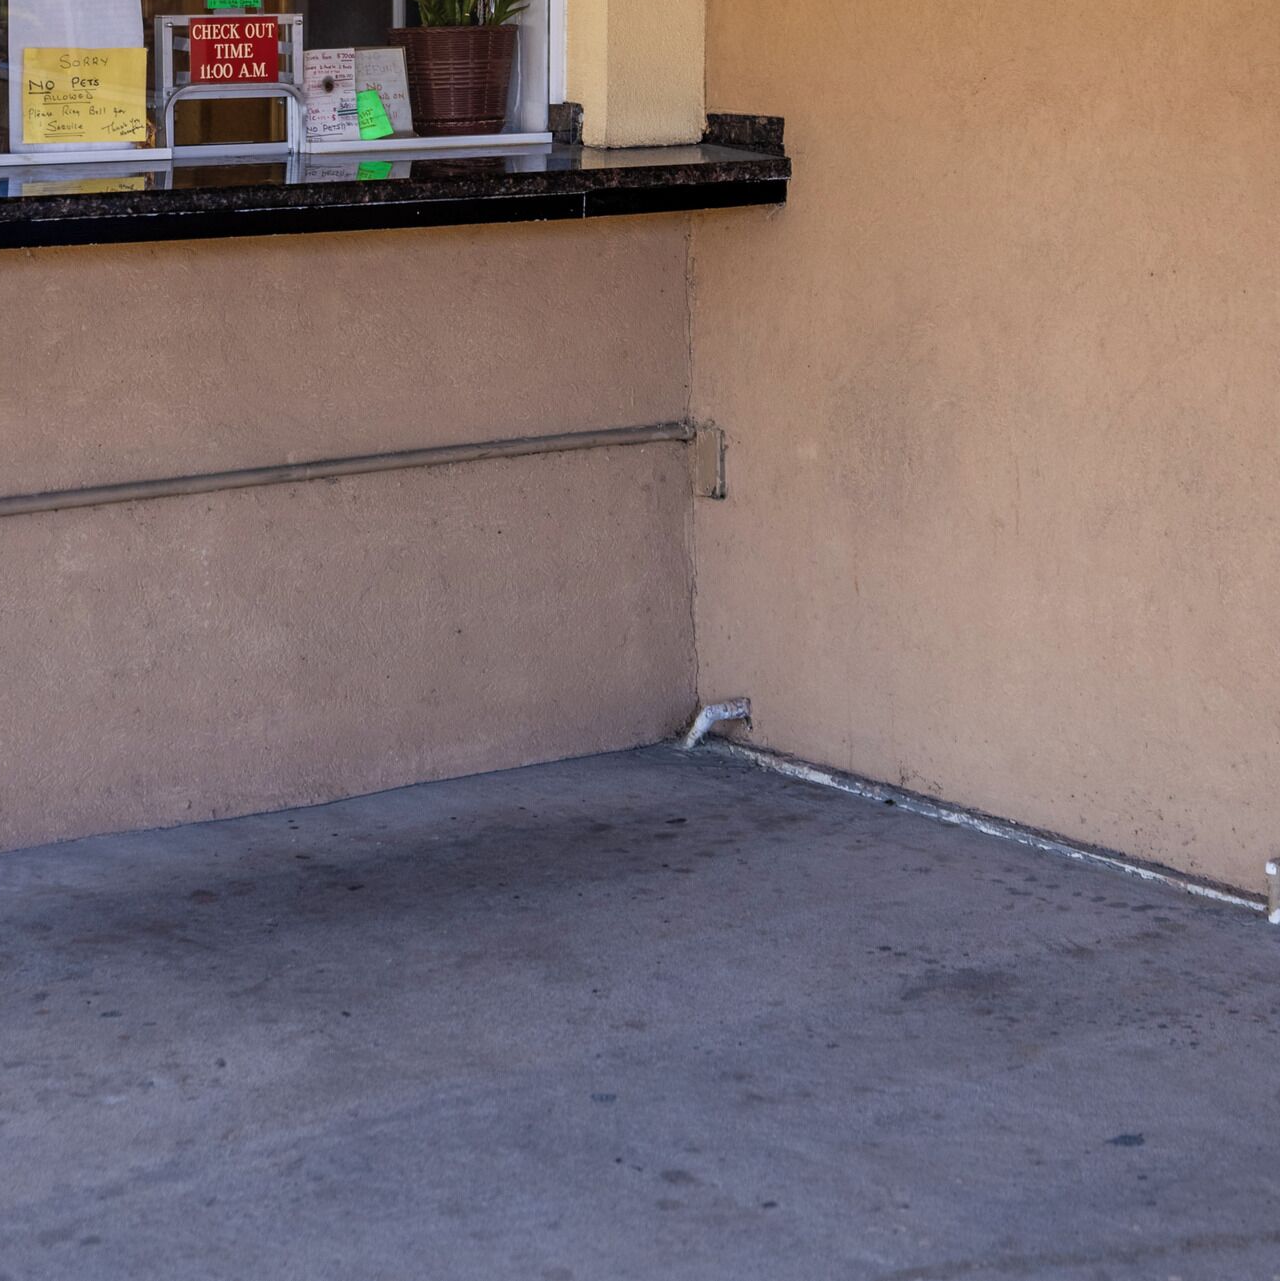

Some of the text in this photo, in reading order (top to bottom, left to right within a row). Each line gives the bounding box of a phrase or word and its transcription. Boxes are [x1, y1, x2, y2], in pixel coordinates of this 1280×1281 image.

[192, 23, 275, 40] CHECK OUT
[214, 43, 254, 59] TIME
[200, 62, 269, 79] 11:00 A.M.
[28, 79, 55, 91] NO
